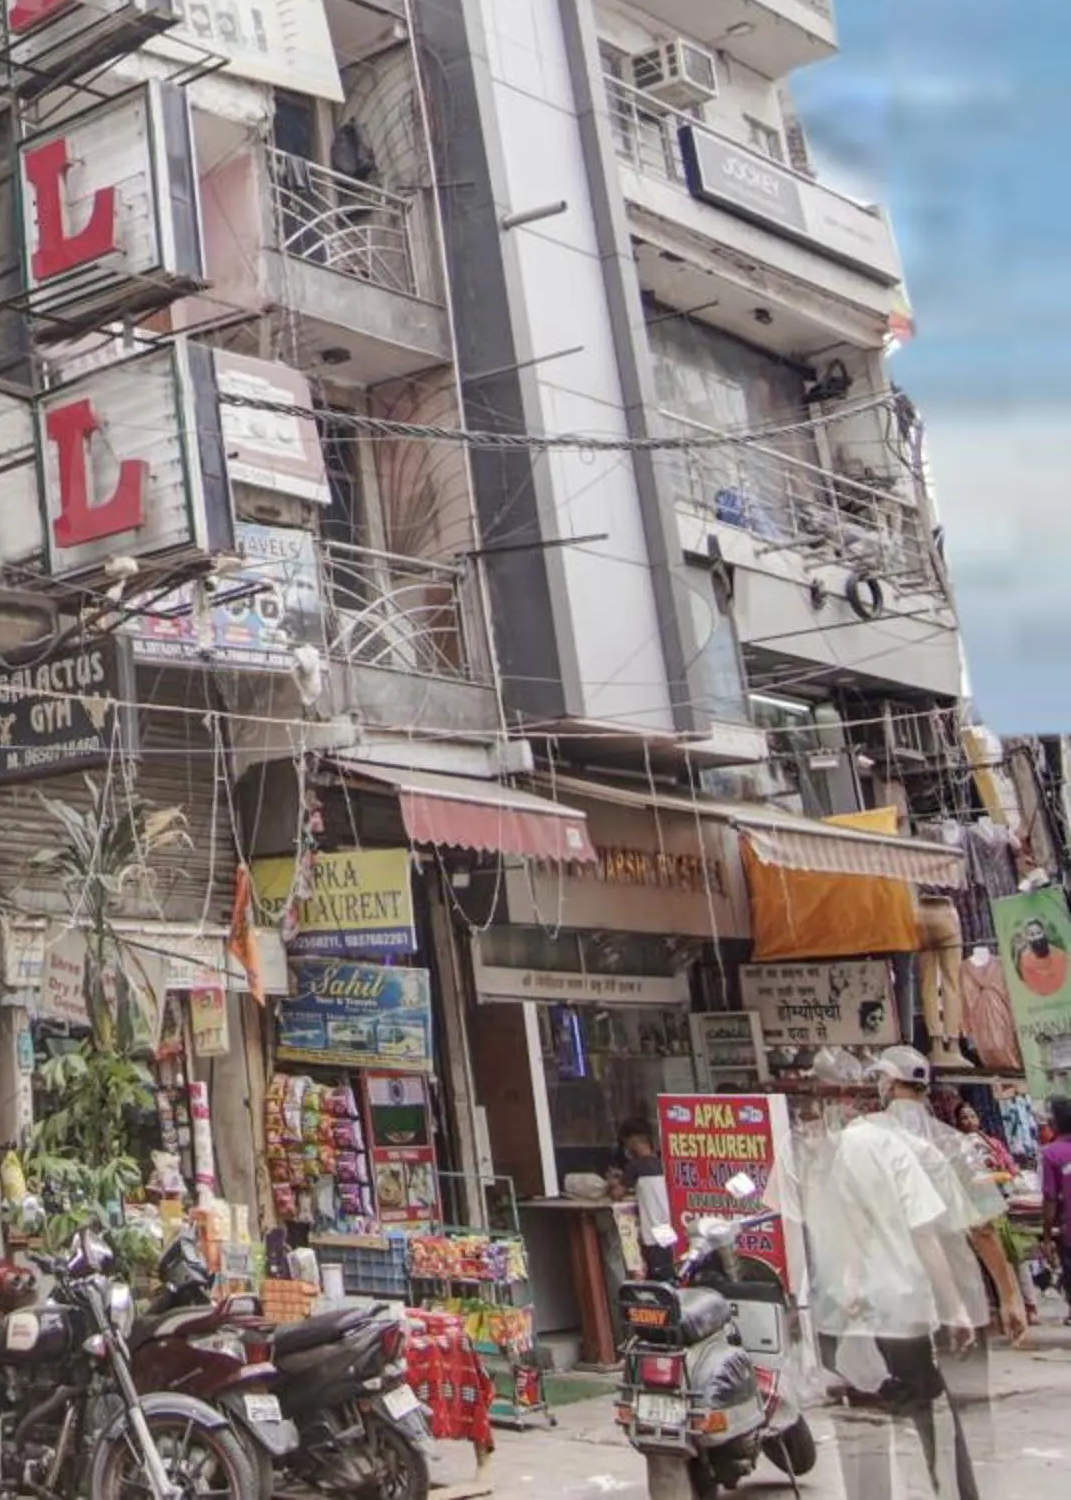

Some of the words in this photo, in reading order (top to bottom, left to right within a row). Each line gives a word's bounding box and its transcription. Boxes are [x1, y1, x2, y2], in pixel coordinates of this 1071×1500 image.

[313, 964, 385, 998] Sahil
[694, 1103, 737, 1129] APKA
[667, 1132, 767, 1161] RESTAURENT
